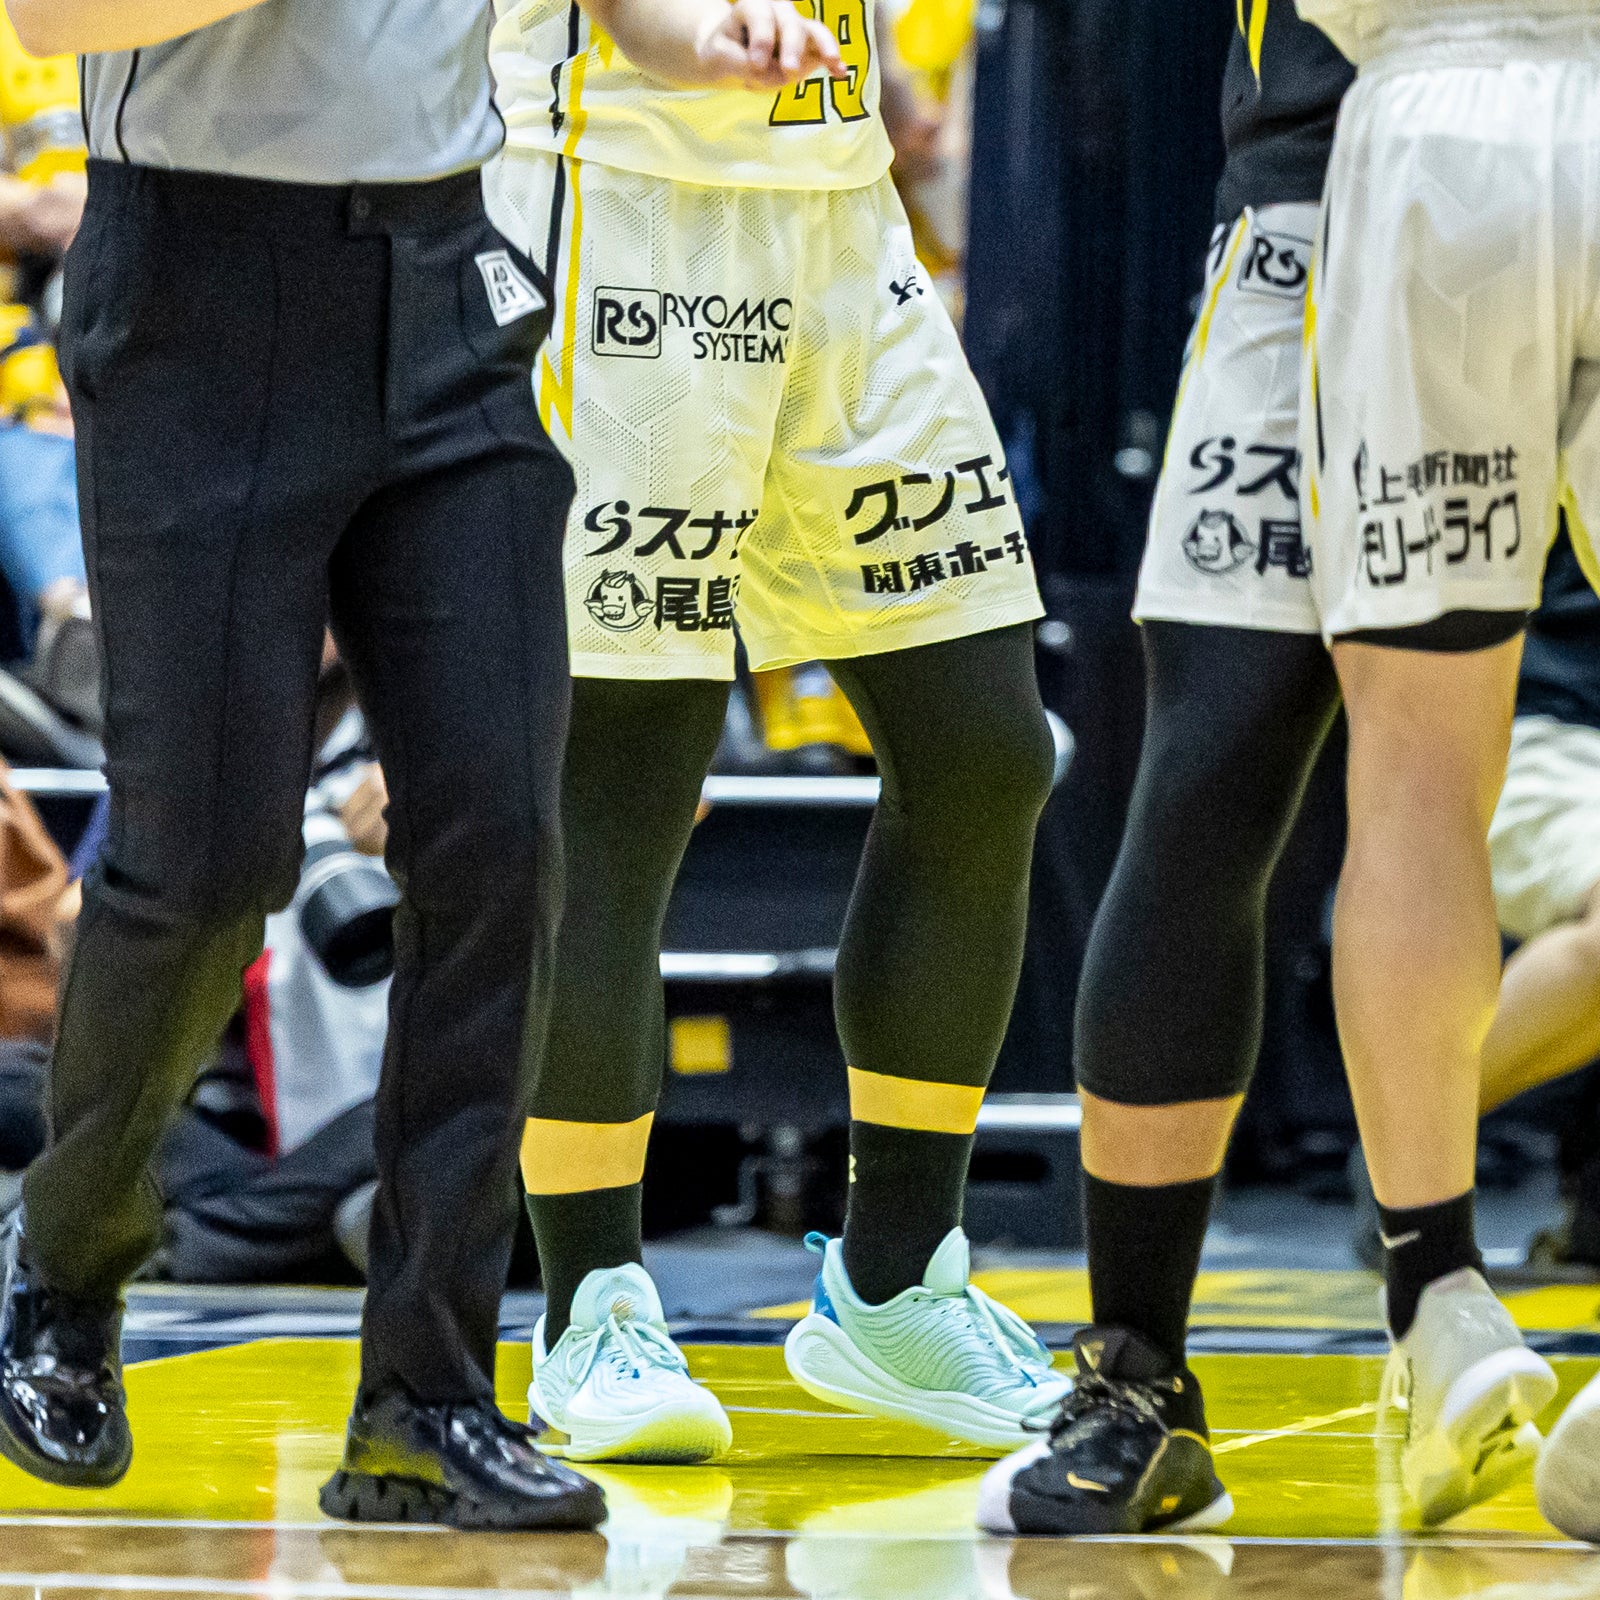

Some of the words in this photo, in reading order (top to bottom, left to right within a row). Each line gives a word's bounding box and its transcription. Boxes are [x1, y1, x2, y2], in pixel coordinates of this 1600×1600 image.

[661, 293, 793, 332] RYOMO
[693, 331, 789, 364] SYSTEM
[844, 454, 1009, 545] グンエ
